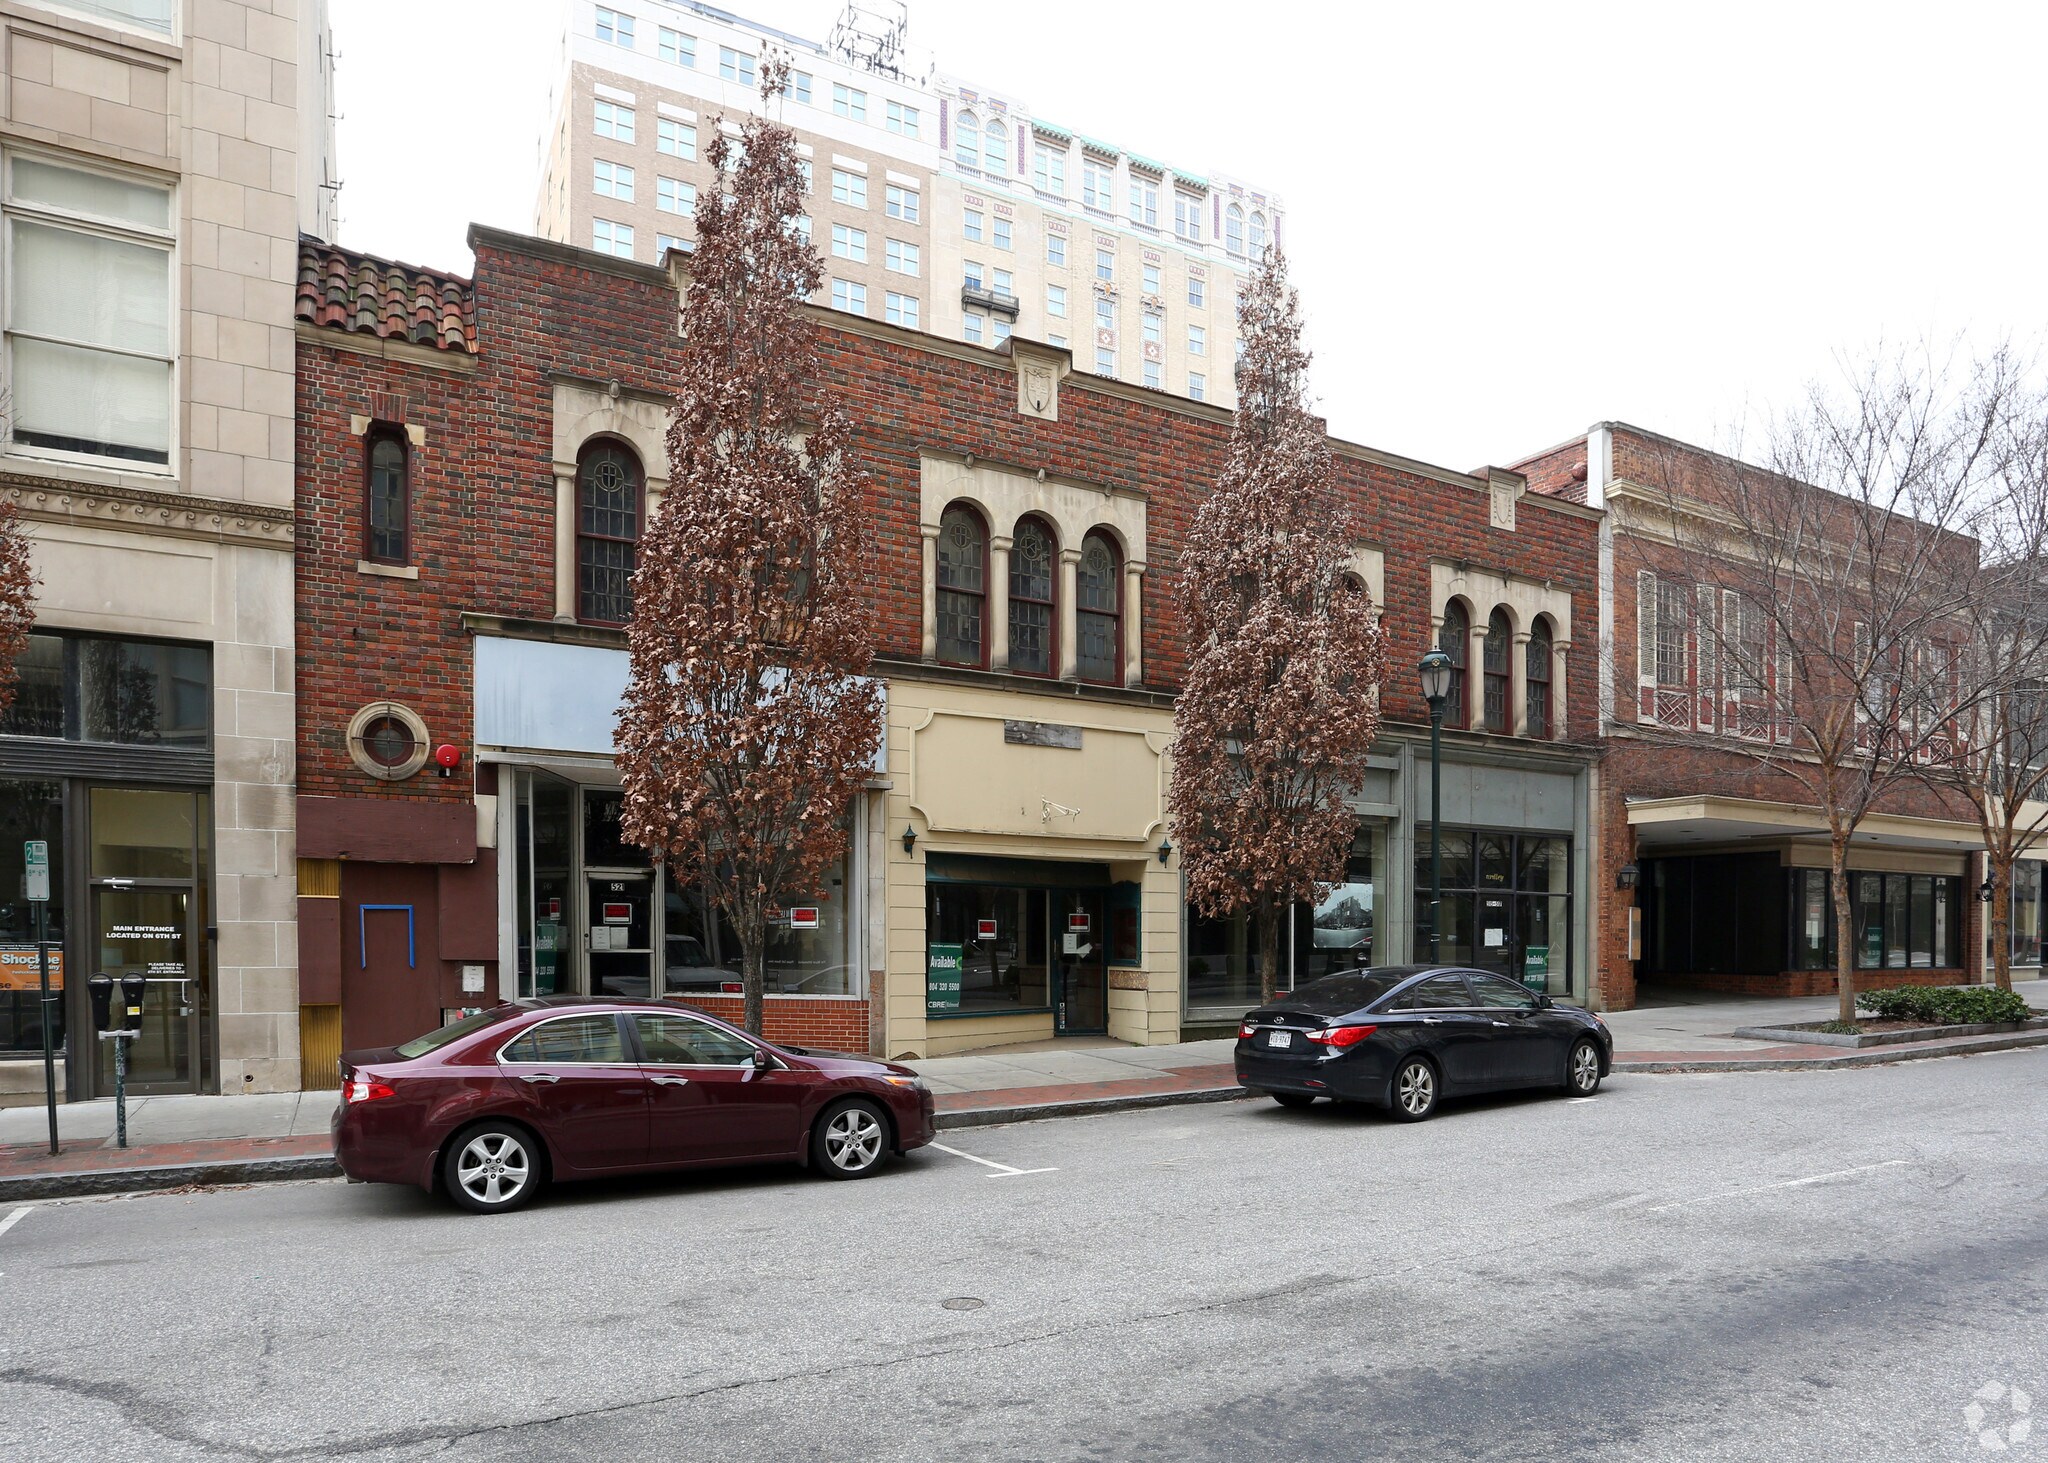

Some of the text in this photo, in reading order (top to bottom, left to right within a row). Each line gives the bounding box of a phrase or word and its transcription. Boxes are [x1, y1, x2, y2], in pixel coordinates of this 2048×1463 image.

[27, 846, 32, 861] 2
[930, 956, 956, 968] Available
[1526, 955, 1543, 965] Available
[929, 983, 960, 991] 804 320 5500
